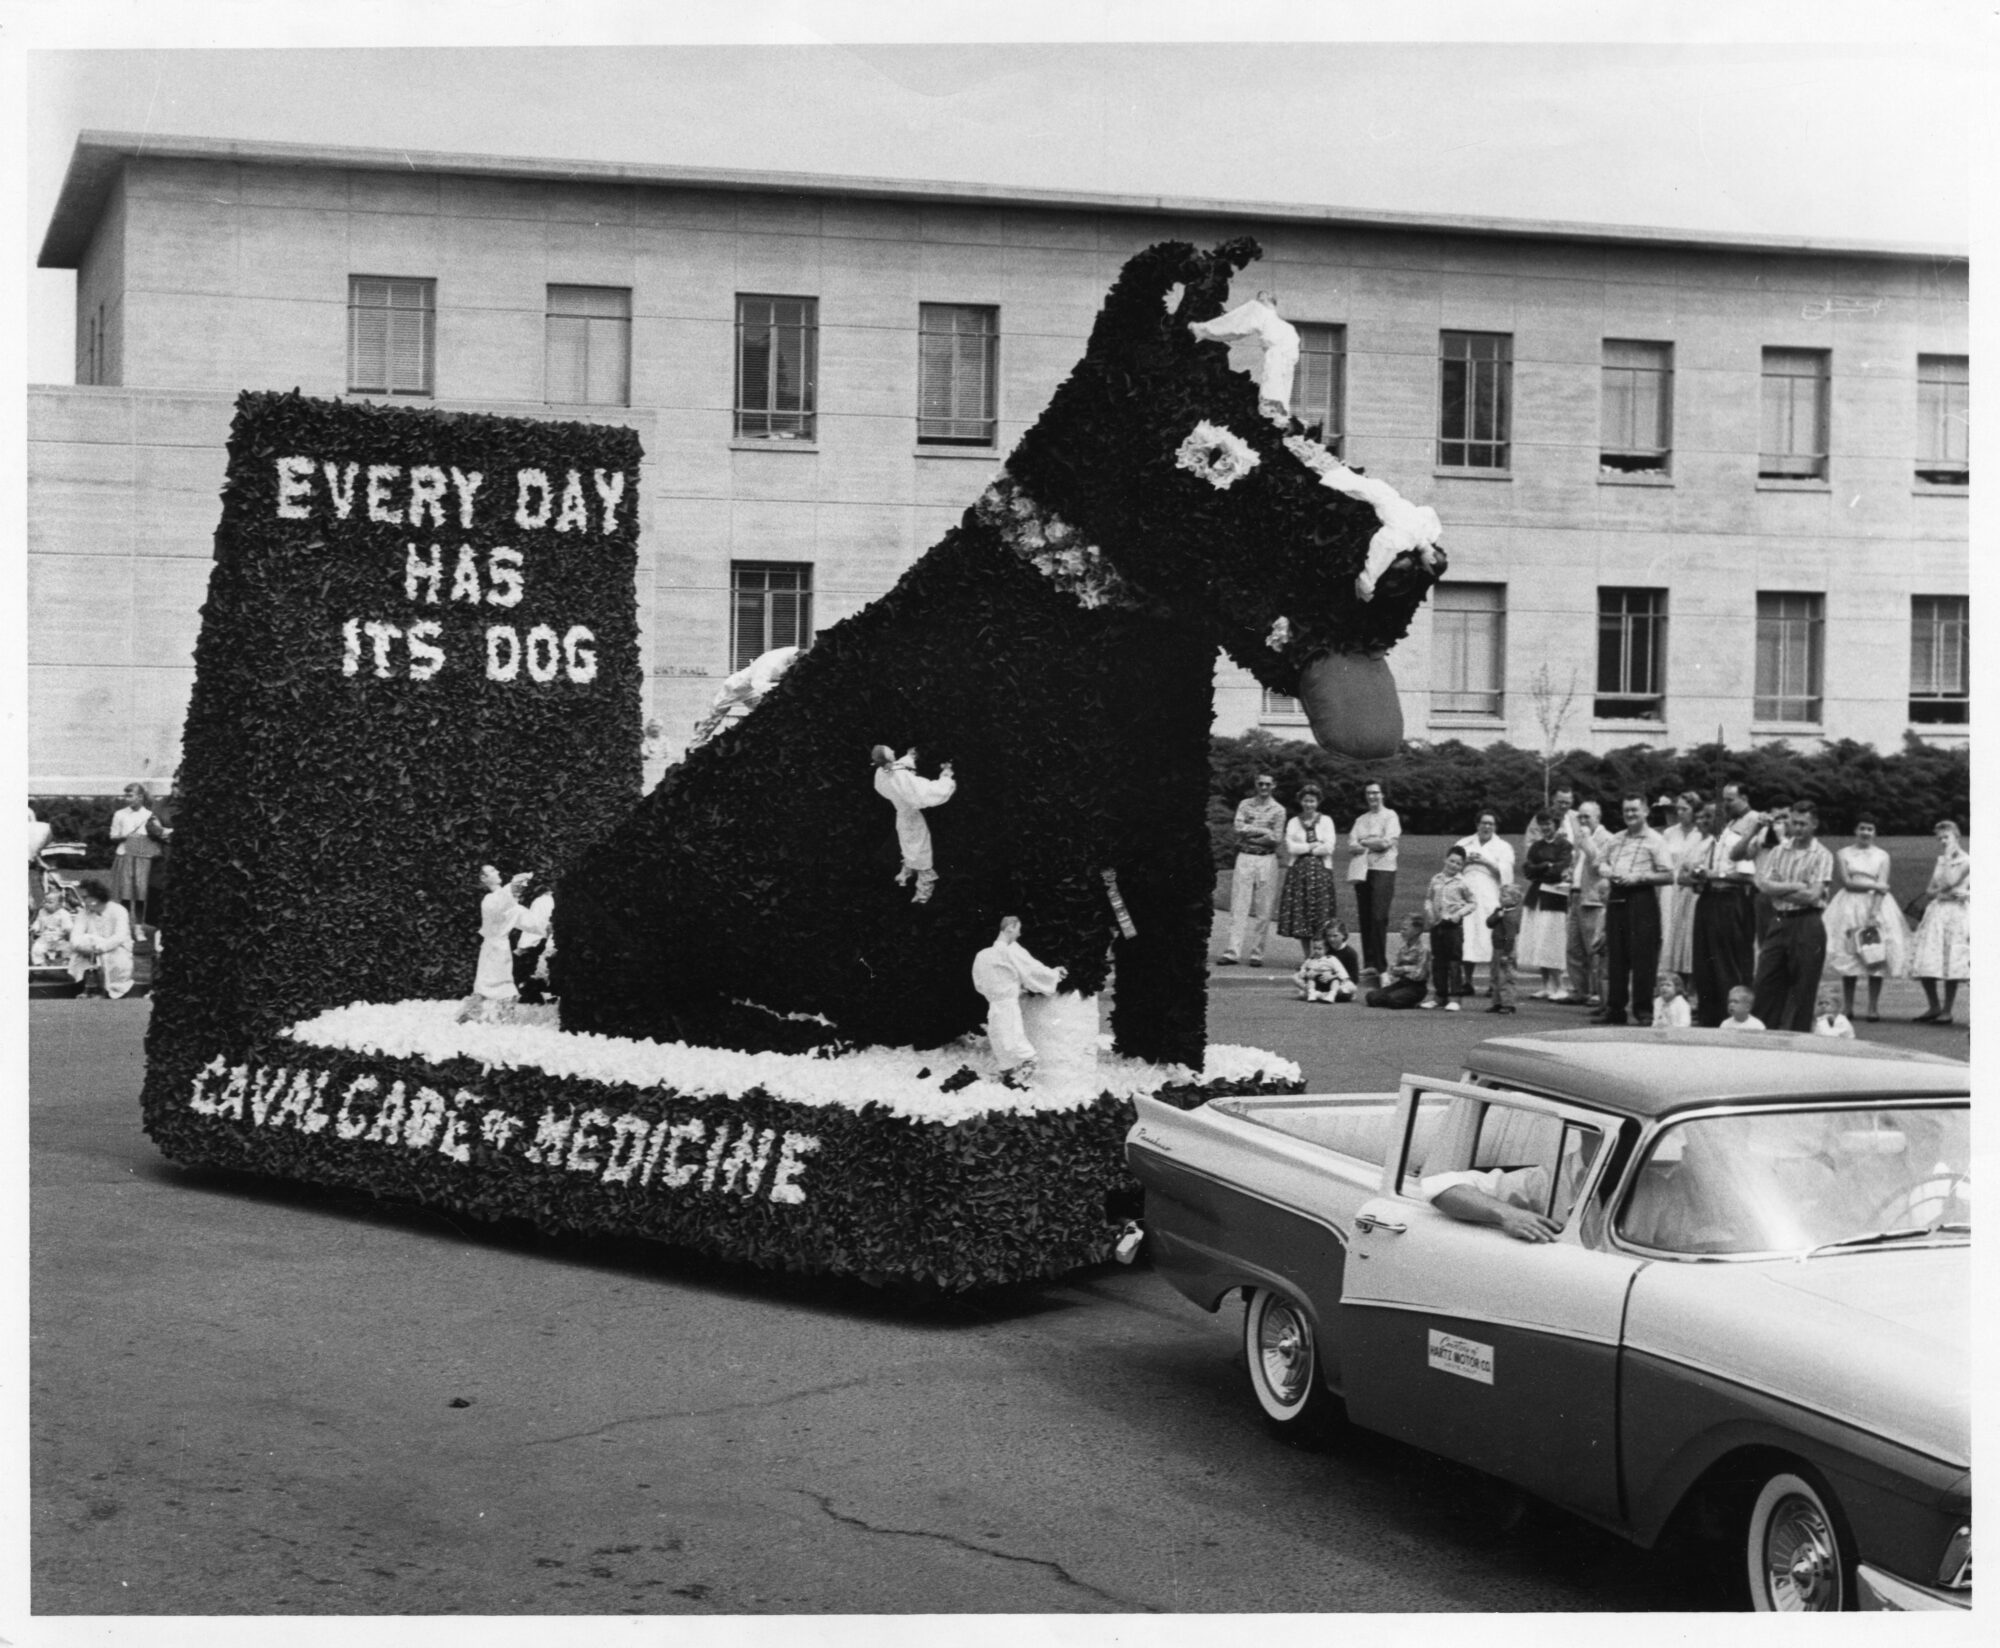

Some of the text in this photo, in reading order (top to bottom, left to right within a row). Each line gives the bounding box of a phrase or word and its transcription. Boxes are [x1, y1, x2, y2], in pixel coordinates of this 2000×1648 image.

[275, 454, 624, 535] EVERY DAY
[405, 543, 525, 607] HAS
[342, 617, 597, 684] ITS DOG
[190, 1054, 483, 1162] CAVALCADE
[525, 1103, 821, 1204] MEDICINE
[1453, 1351, 1480, 1369] MOTOR
